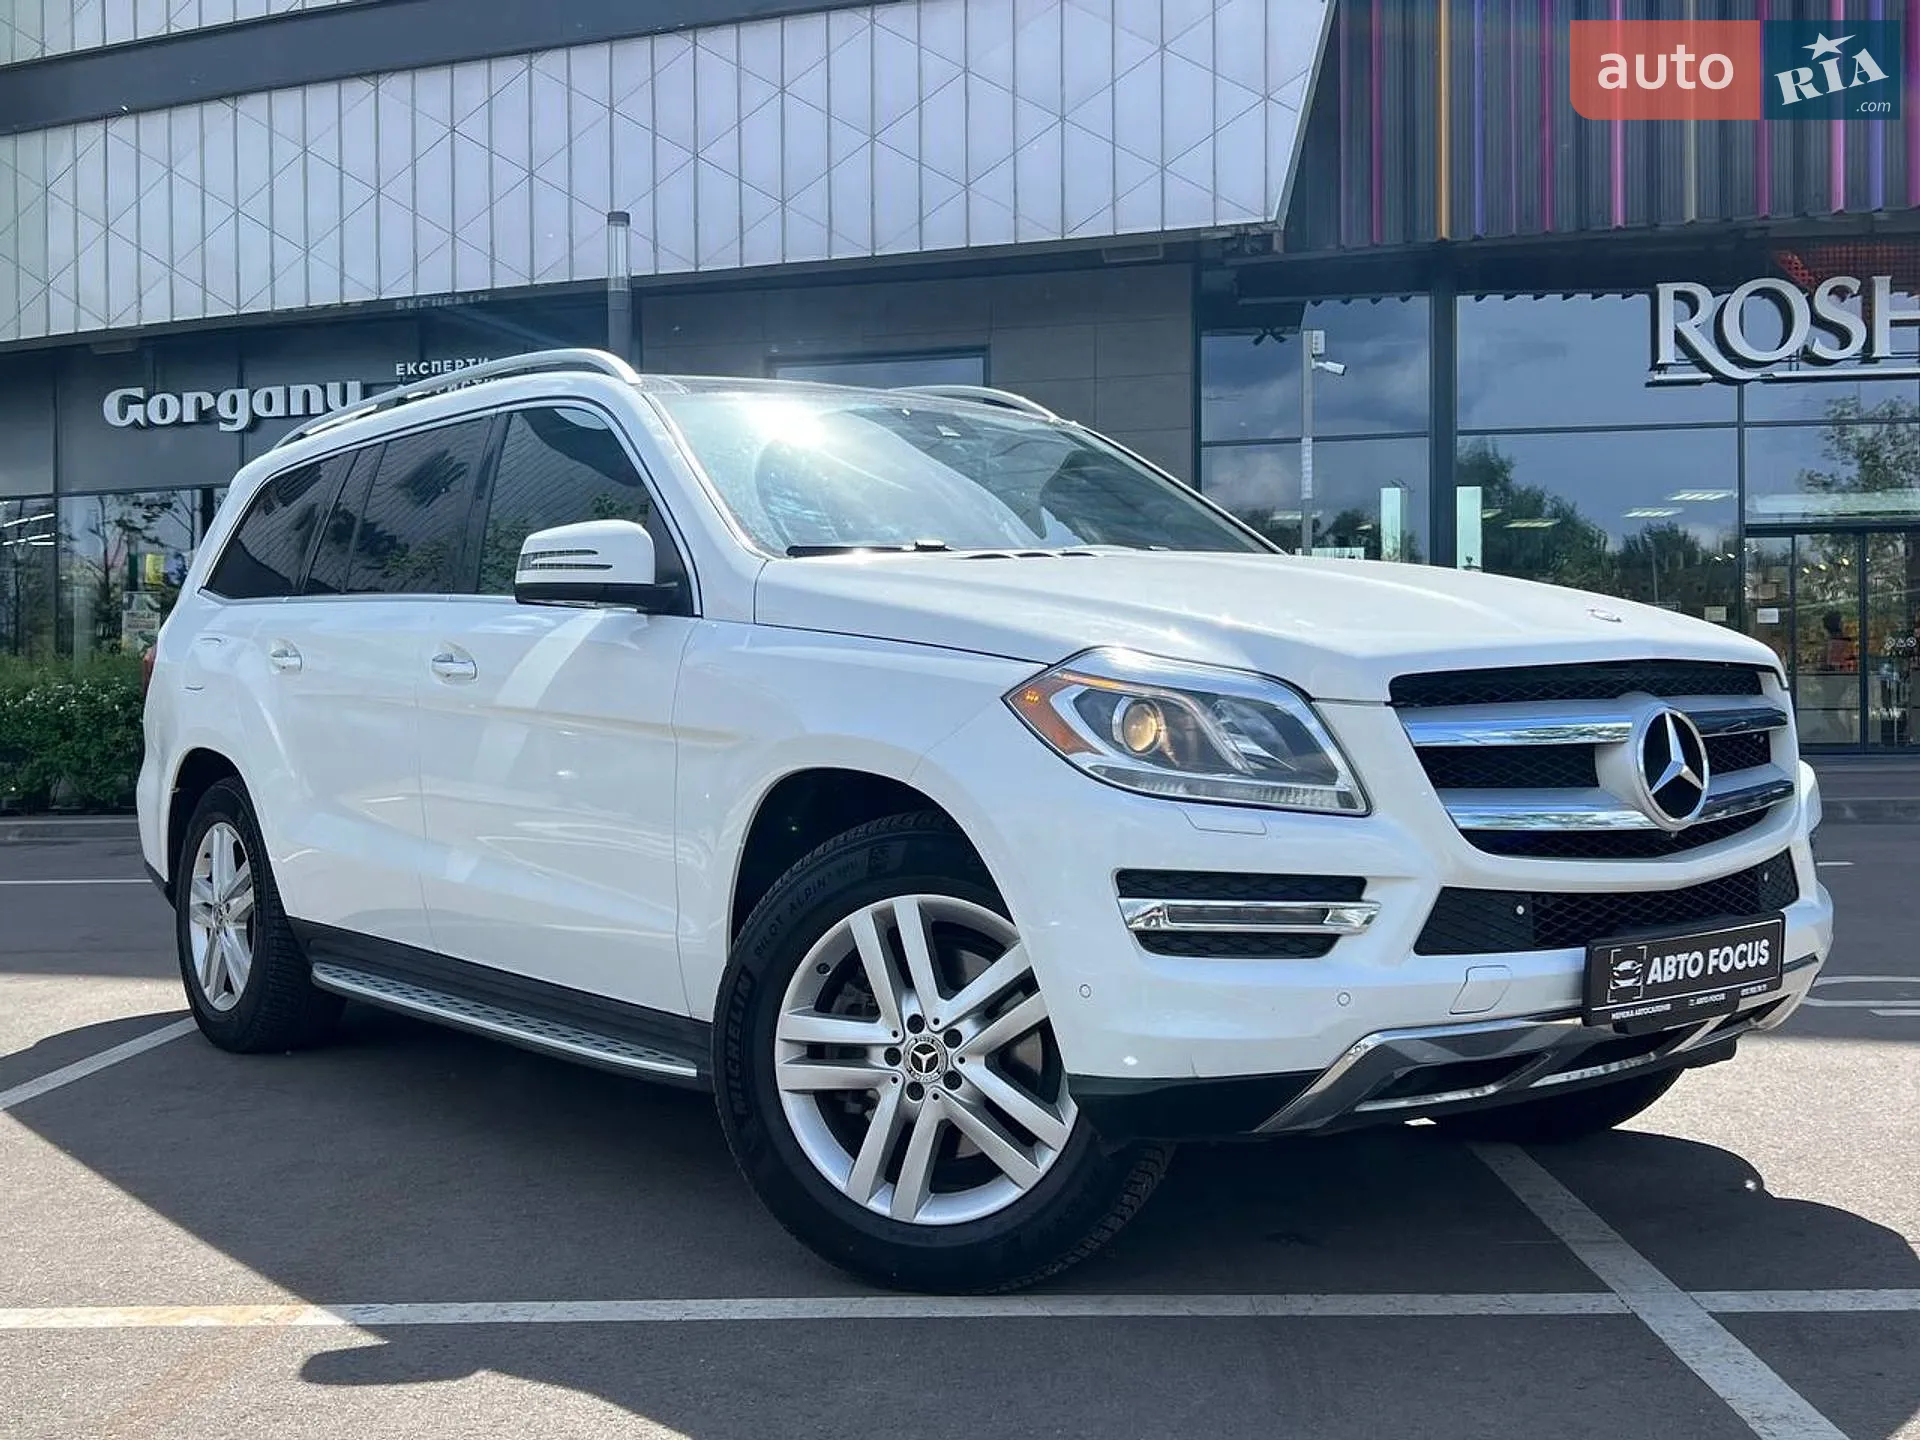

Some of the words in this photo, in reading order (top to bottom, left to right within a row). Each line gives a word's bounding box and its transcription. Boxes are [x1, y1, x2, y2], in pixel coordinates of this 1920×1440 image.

[1646, 951, 1704, 985] АВТО
[1707, 939, 1770, 975] FOCUS
[725, 970, 757, 1118] MICHELIN
